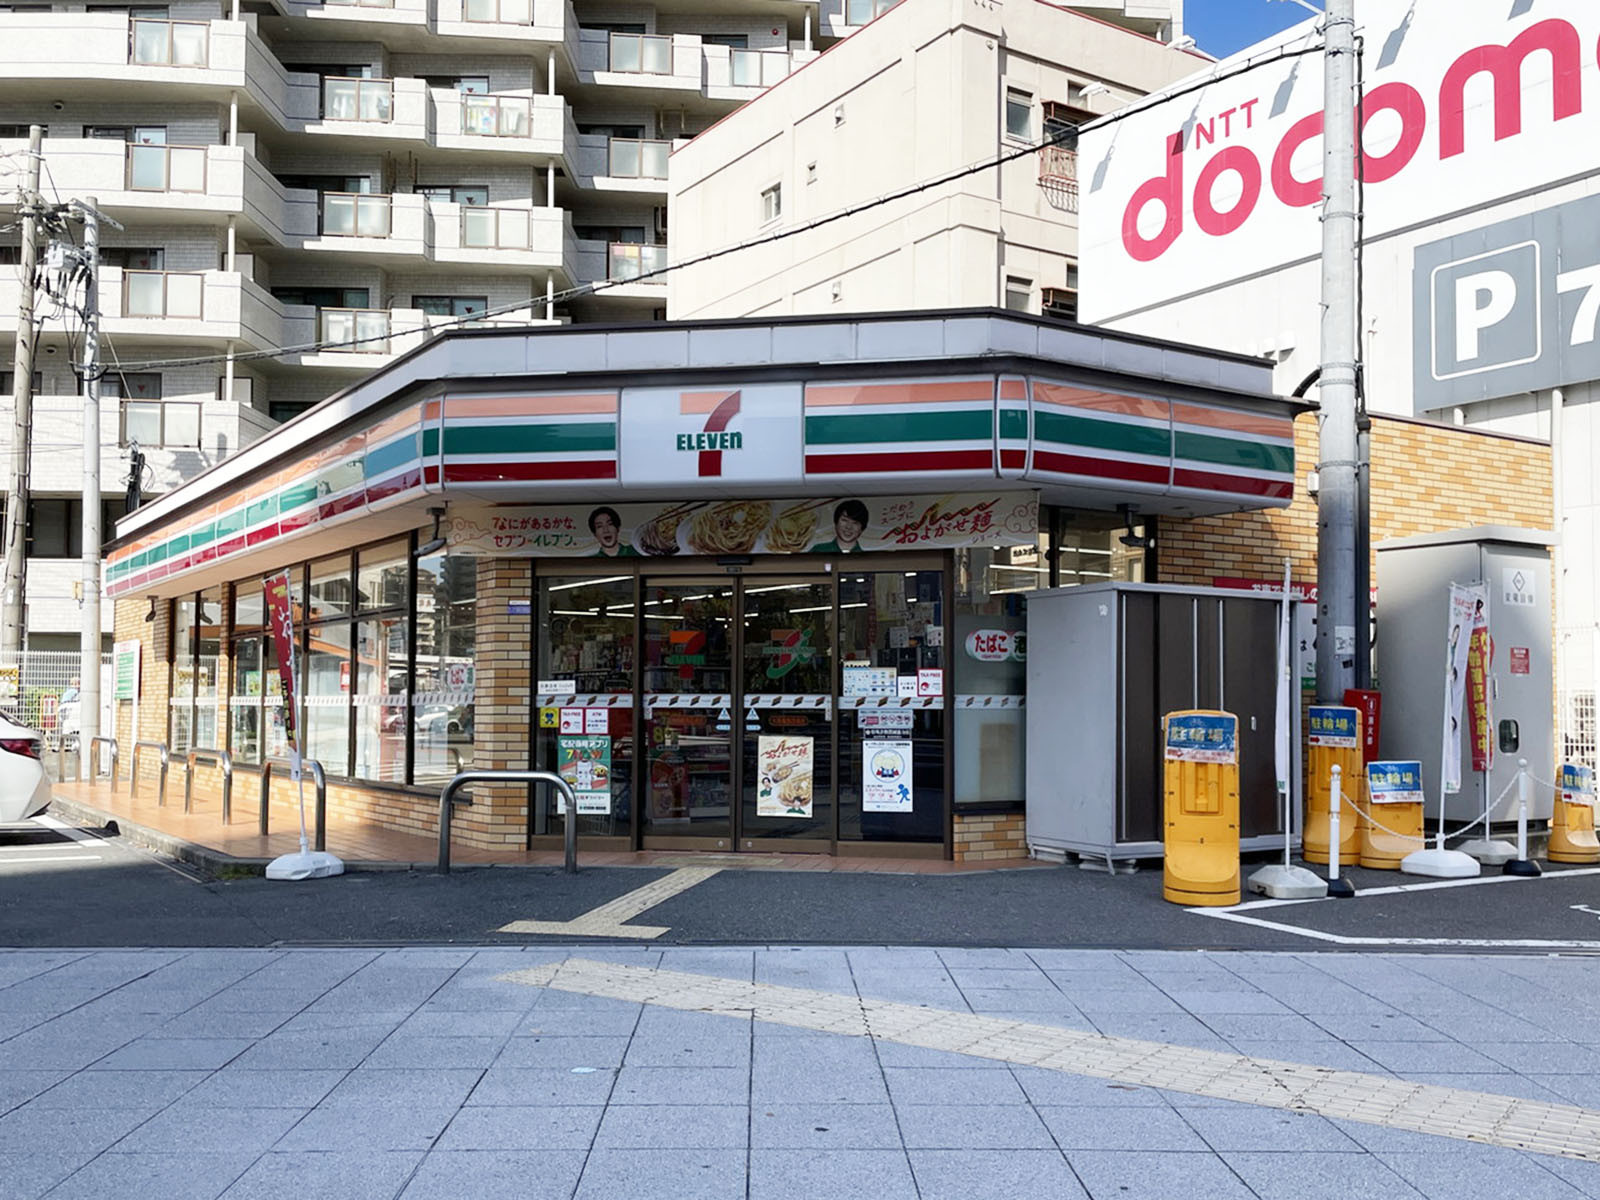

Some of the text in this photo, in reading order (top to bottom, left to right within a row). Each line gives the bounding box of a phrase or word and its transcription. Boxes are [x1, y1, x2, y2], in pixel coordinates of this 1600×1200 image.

[1121, 17, 1600, 262] docom
[1196, 97, 1259, 150] NTT
[1454, 269, 1517, 363] P
[974, 634, 1008, 653] たばこ
